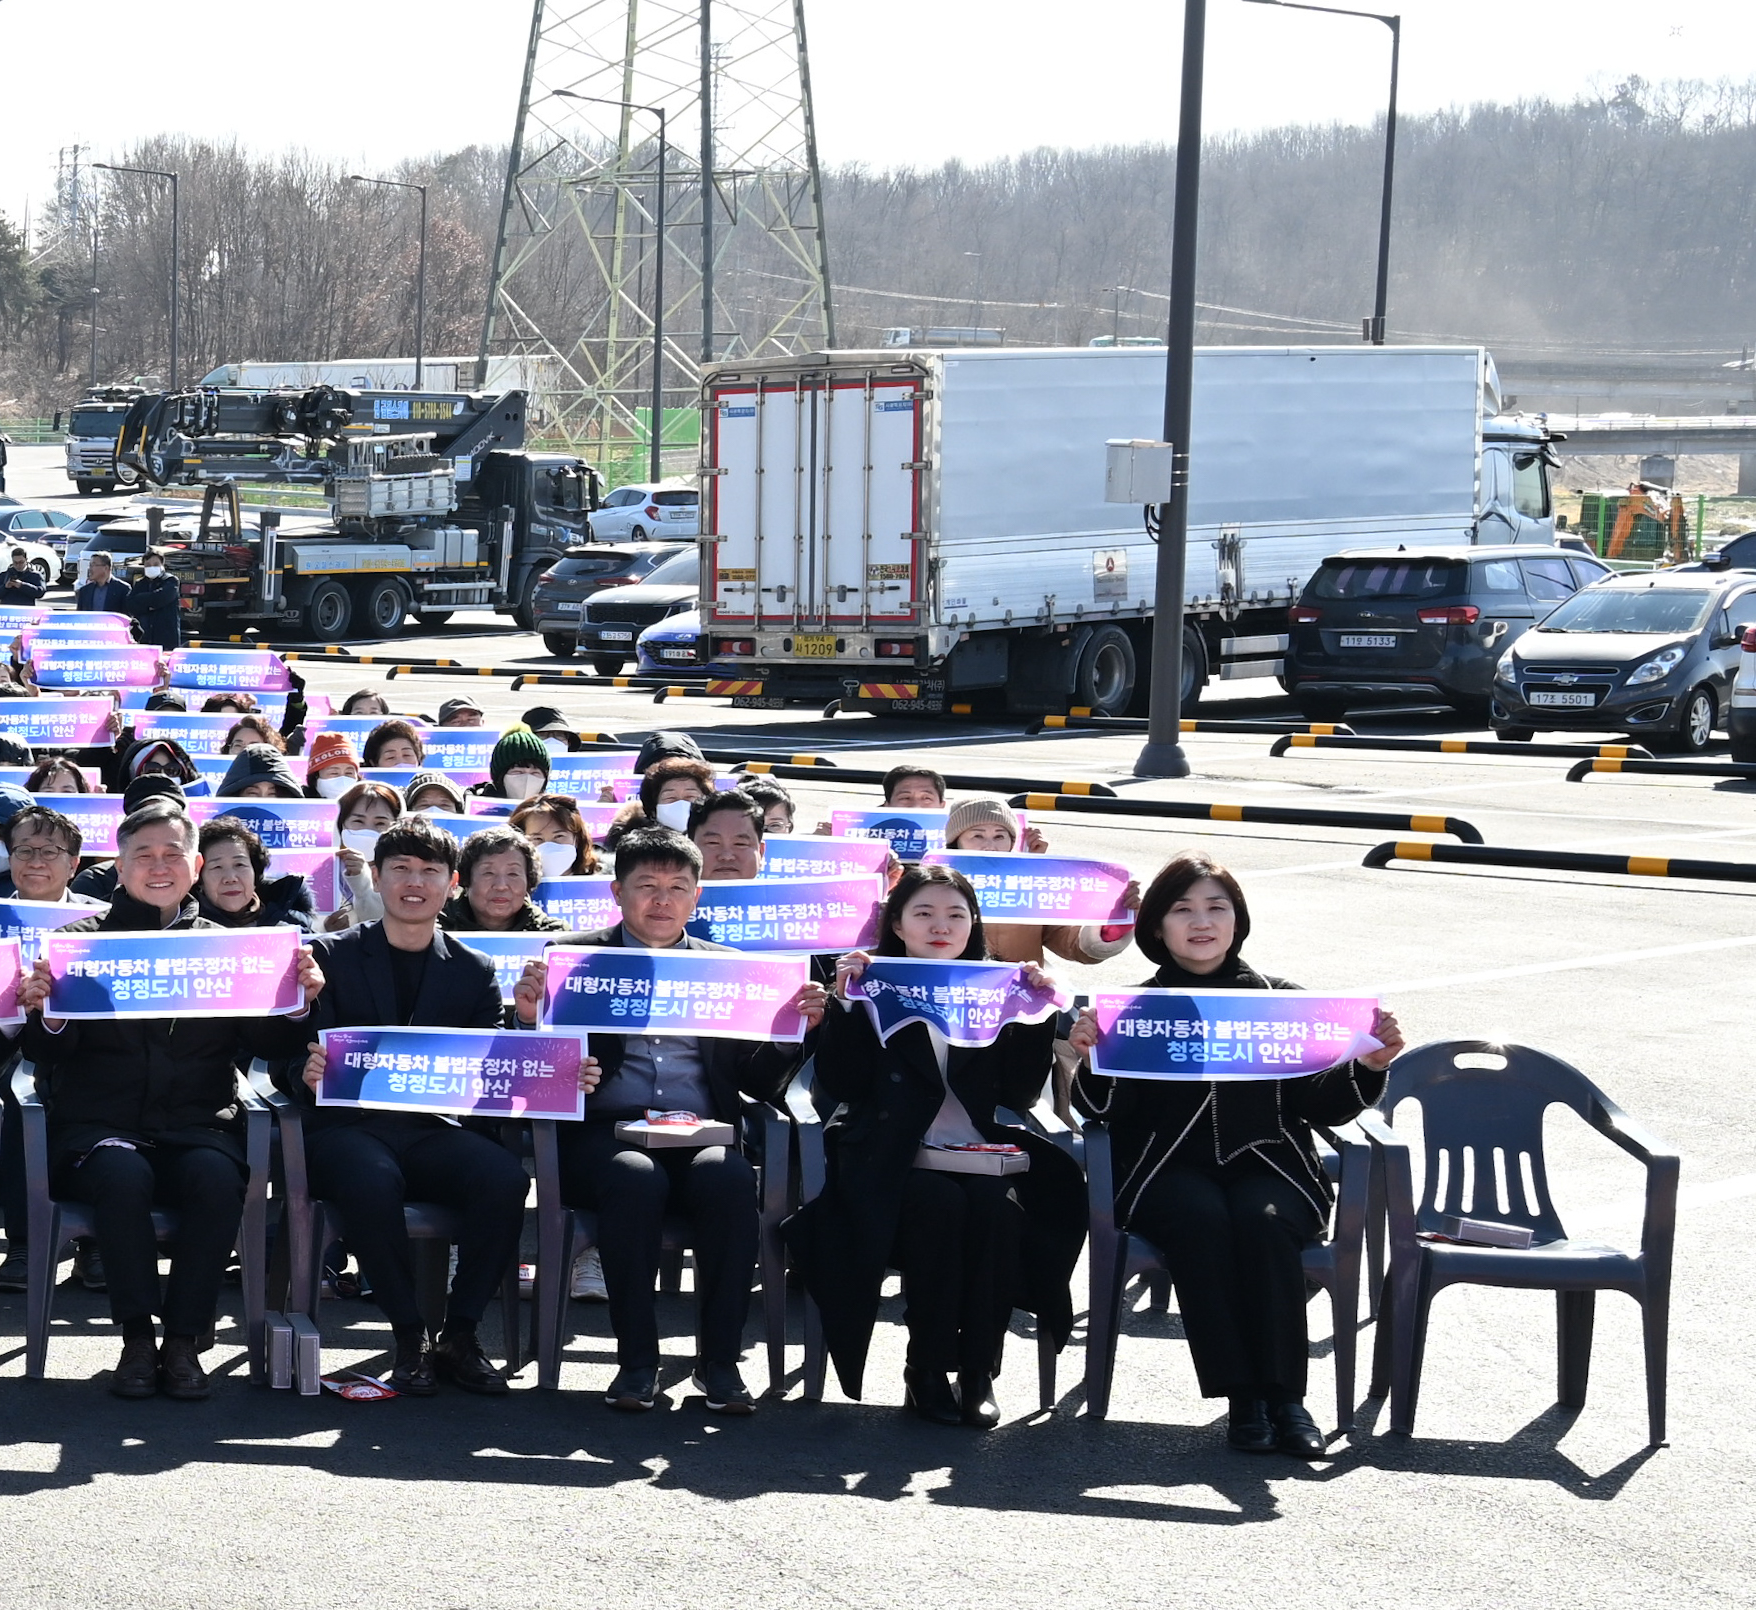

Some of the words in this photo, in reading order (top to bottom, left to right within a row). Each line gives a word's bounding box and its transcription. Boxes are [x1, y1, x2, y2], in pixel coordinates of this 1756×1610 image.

[1366, 637, 1391, 646] 5133
[40, 661, 84, 670] 대형자동차
[83, 661, 129, 670] 불법주정차
[128, 660, 148, 670] 없는
[63, 671, 103, 682] 청정도시
[105, 671, 126, 682] 안산
[1561, 694, 1588, 704] 5501
[314, 749, 349, 763] KOLON
[747, 903, 823, 920] 불법주정차
[827, 901, 857, 918] 없는
[709, 924, 778, 942] 청정도시
[784, 921, 820, 940] 안산
[67, 959, 150, 977] 대형자동차
[153, 957, 237, 976] 불법주정차
[241, 956, 275, 974] 없는
[112, 978, 188, 999] 청정도시
[193, 977, 233, 998] 안산
[565, 977, 651, 996] 대형자동차
[654, 980, 741, 1000] 불법주정차
[745, 984, 780, 1001] 없는
[932, 985, 1007, 1005] 불법주정차
[610, 998, 688, 1017] 청정도시
[693, 1001, 734, 1020] 안산
[967, 1007, 1001, 1029] 안산
[1117, 1019, 1210, 1038] 대형자동차
[1214, 1021, 1309, 1040] 불법주정차
[1313, 1022, 1351, 1041] 없는
[1167, 1042, 1253, 1062] 청정도시
[1259, 1043, 1304, 1063] 안산
[345, 1052, 430, 1072] 대형자동차
[433, 1056, 517, 1075] 불법주정차
[522, 1060, 555, 1078] 없는
[388, 1074, 466, 1095] 청정도시
[472, 1078, 513, 1099] 안산
